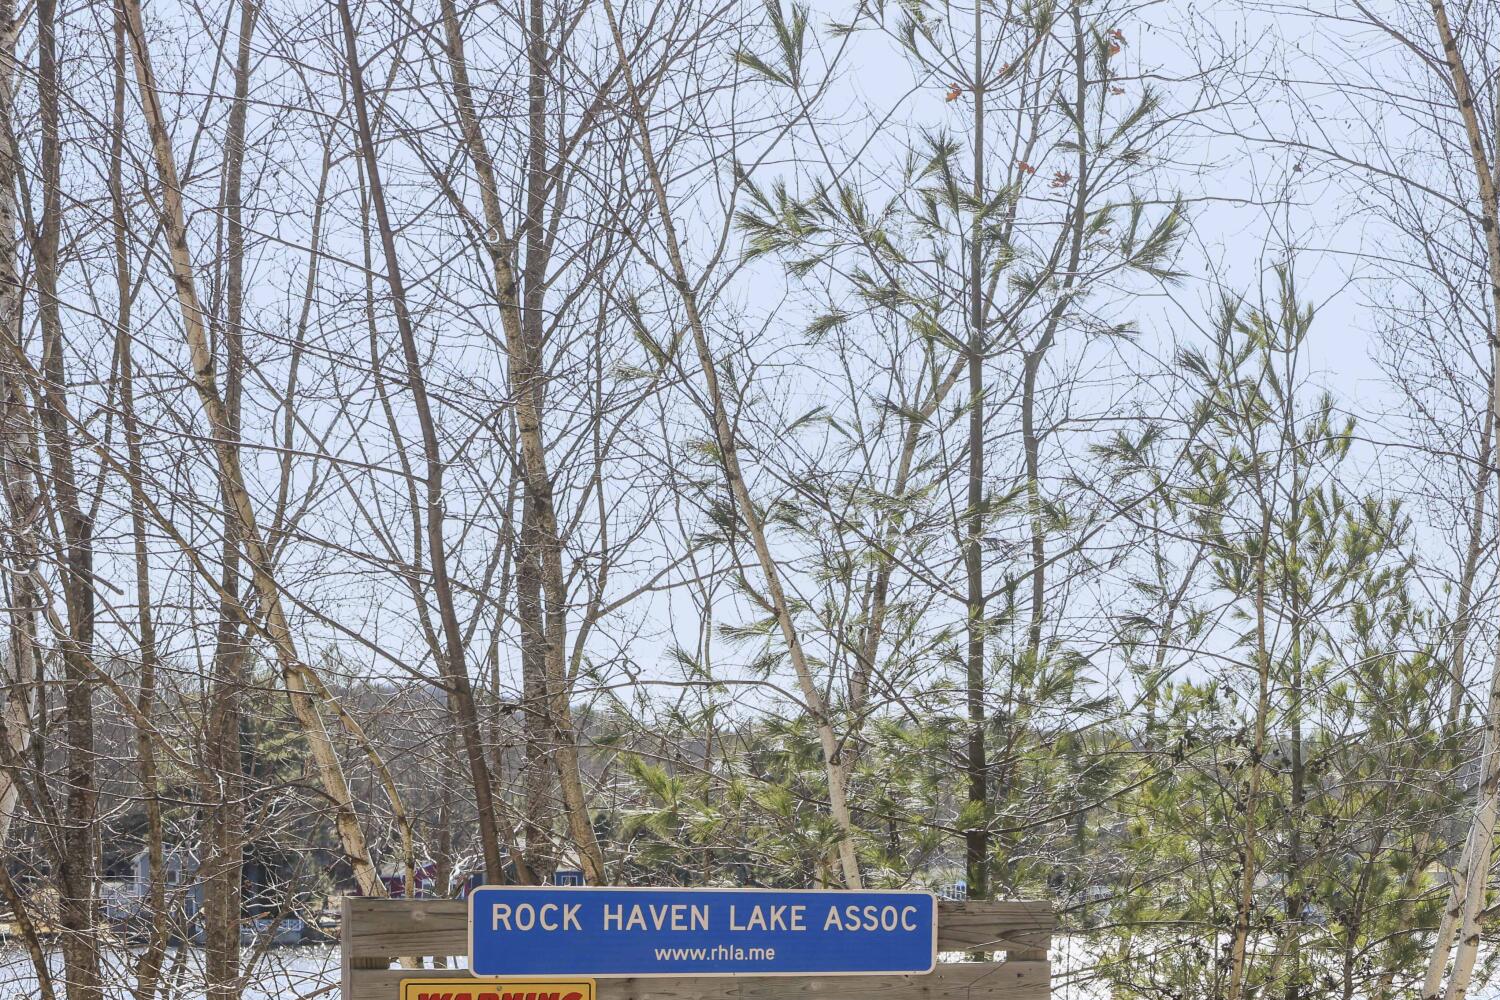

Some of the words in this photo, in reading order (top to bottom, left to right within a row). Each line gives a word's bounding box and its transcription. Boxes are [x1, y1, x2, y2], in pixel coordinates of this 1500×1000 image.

[491, 903, 583, 931] ROCK
[603, 904, 709, 931] HAVEN
[730, 905, 807, 931] LAKE
[823, 905, 918, 932] ASSOC
[654, 944, 776, 961] www.rhla.me
